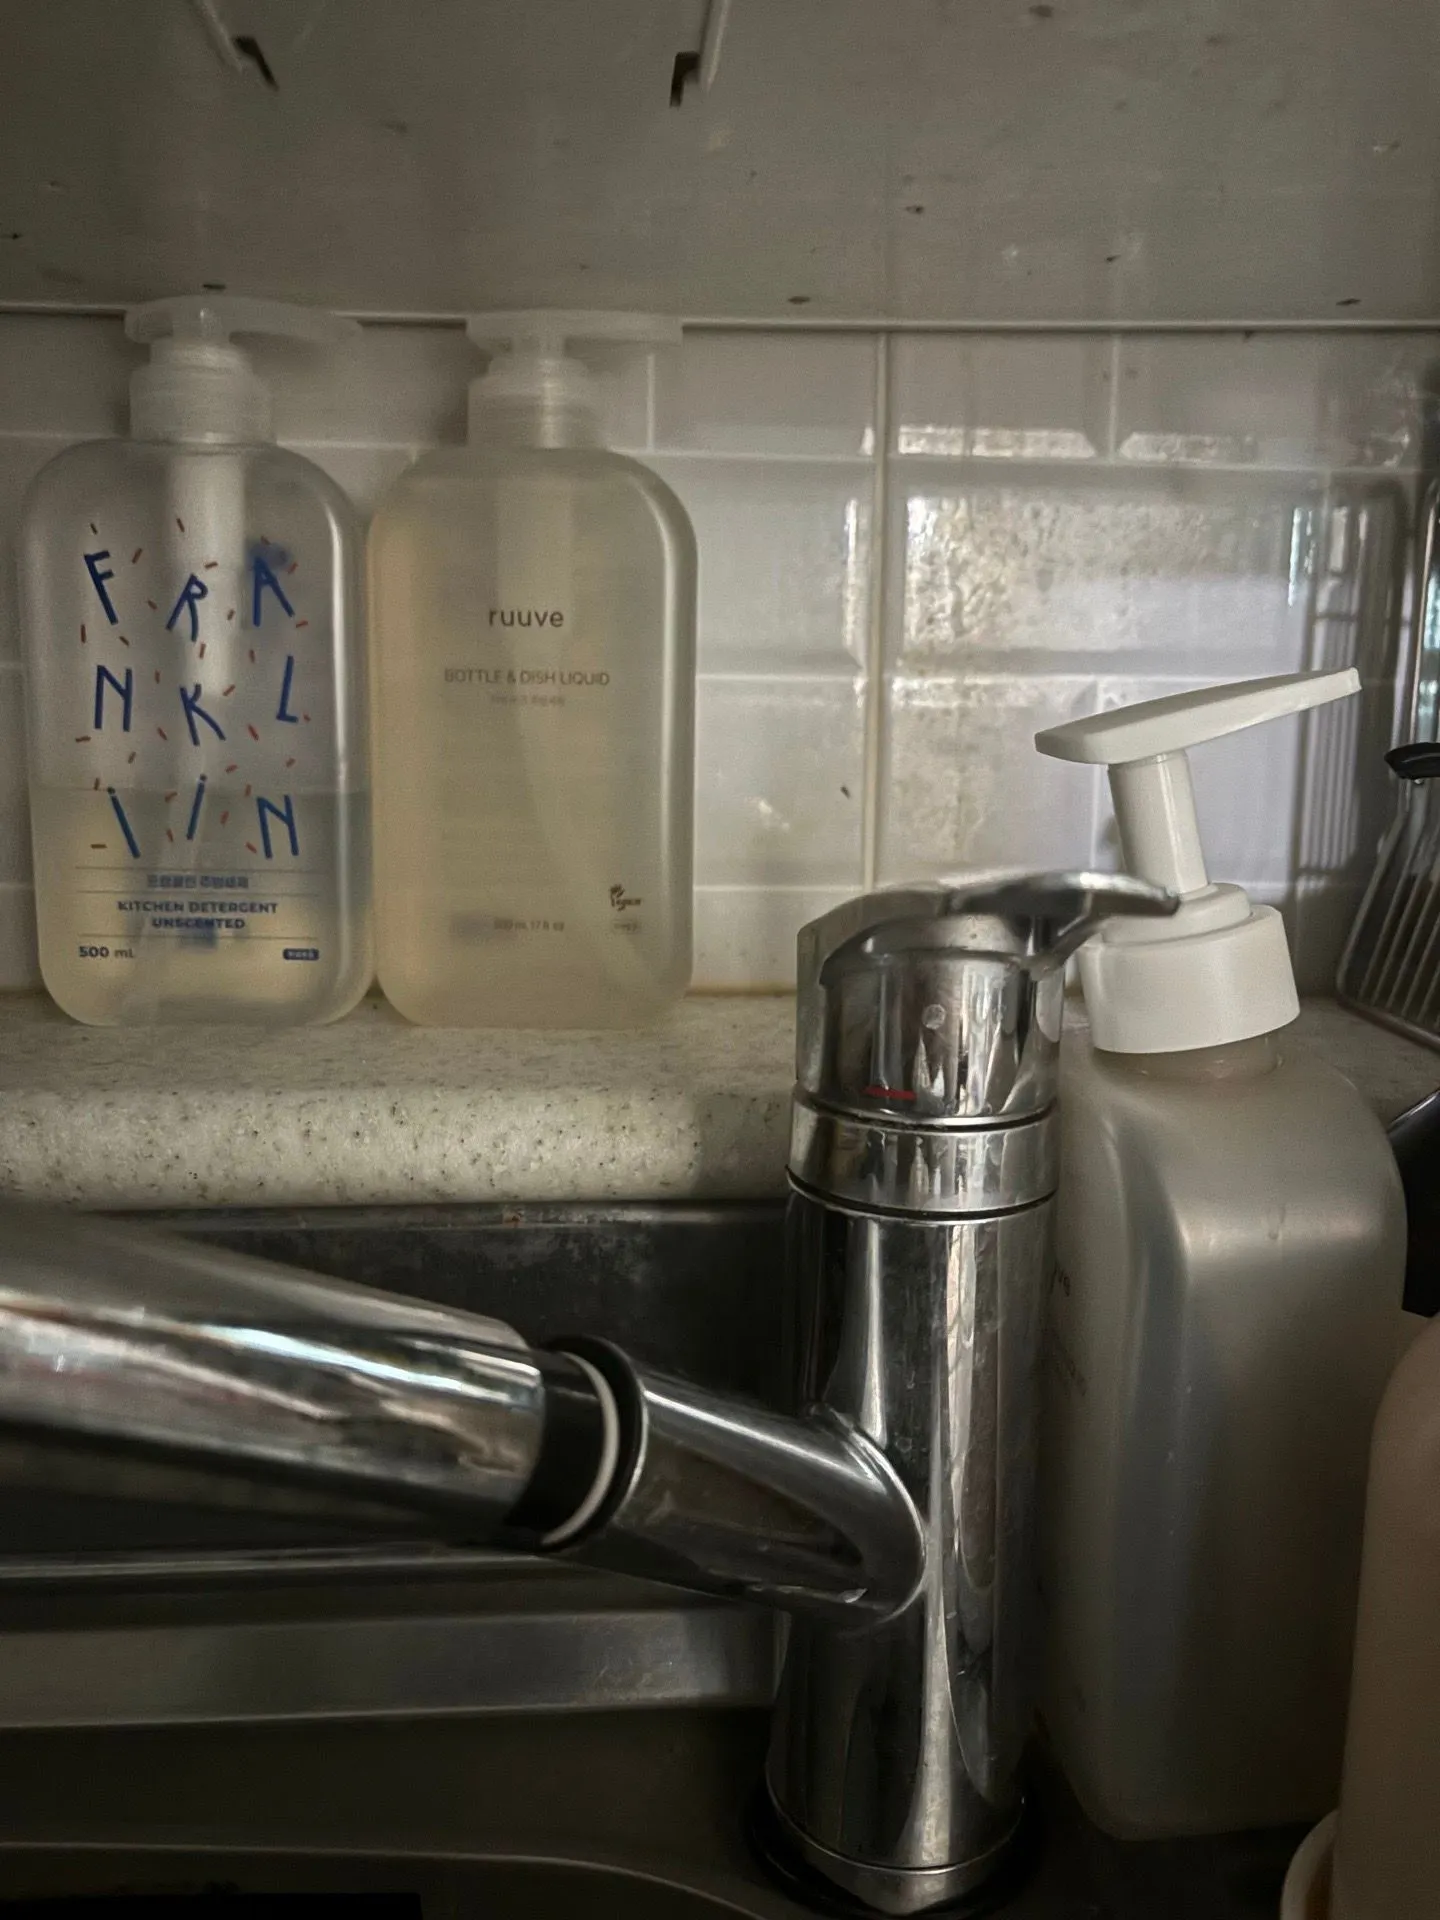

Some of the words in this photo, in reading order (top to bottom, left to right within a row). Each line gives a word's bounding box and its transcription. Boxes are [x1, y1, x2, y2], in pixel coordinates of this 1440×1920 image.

[488, 609, 565, 627] ruuve
[444, 668, 502, 684] BOTTLE
[520, 670, 556, 685] DISH
[559, 671, 611, 687] LIQUID
[117, 901, 184, 912] KITCHEN
[188, 902, 278, 914] DETERGENT
[151, 917, 246, 930] UNSCENTED
[79, 946, 110, 959] 500
